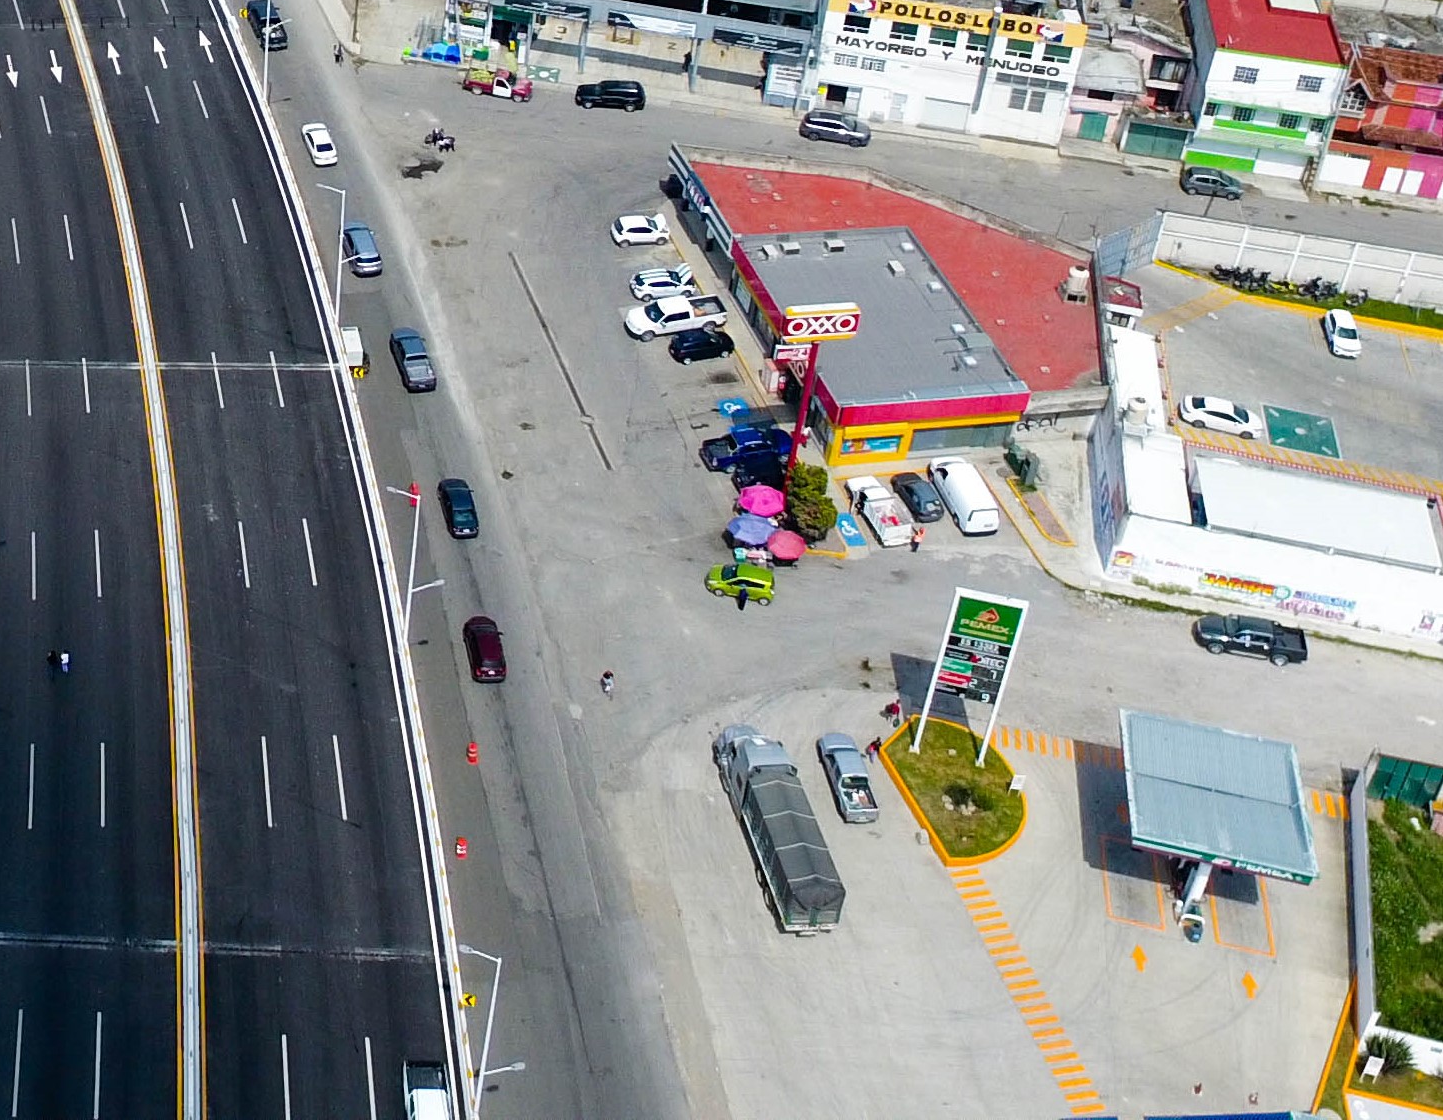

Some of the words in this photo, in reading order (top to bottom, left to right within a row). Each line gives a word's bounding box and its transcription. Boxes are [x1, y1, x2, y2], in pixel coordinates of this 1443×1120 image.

[879, 0, 966, 25] POLLOS
[973, 14, 1033, 34] LOBO
[836, 35, 927, 57] MAYOREO
[942, 50, 953, 61] Y
[966, 54, 1060, 77] MENUDEO
[787, 315, 856, 335] OXXO
[960, 618, 1010, 634] PEMEX
